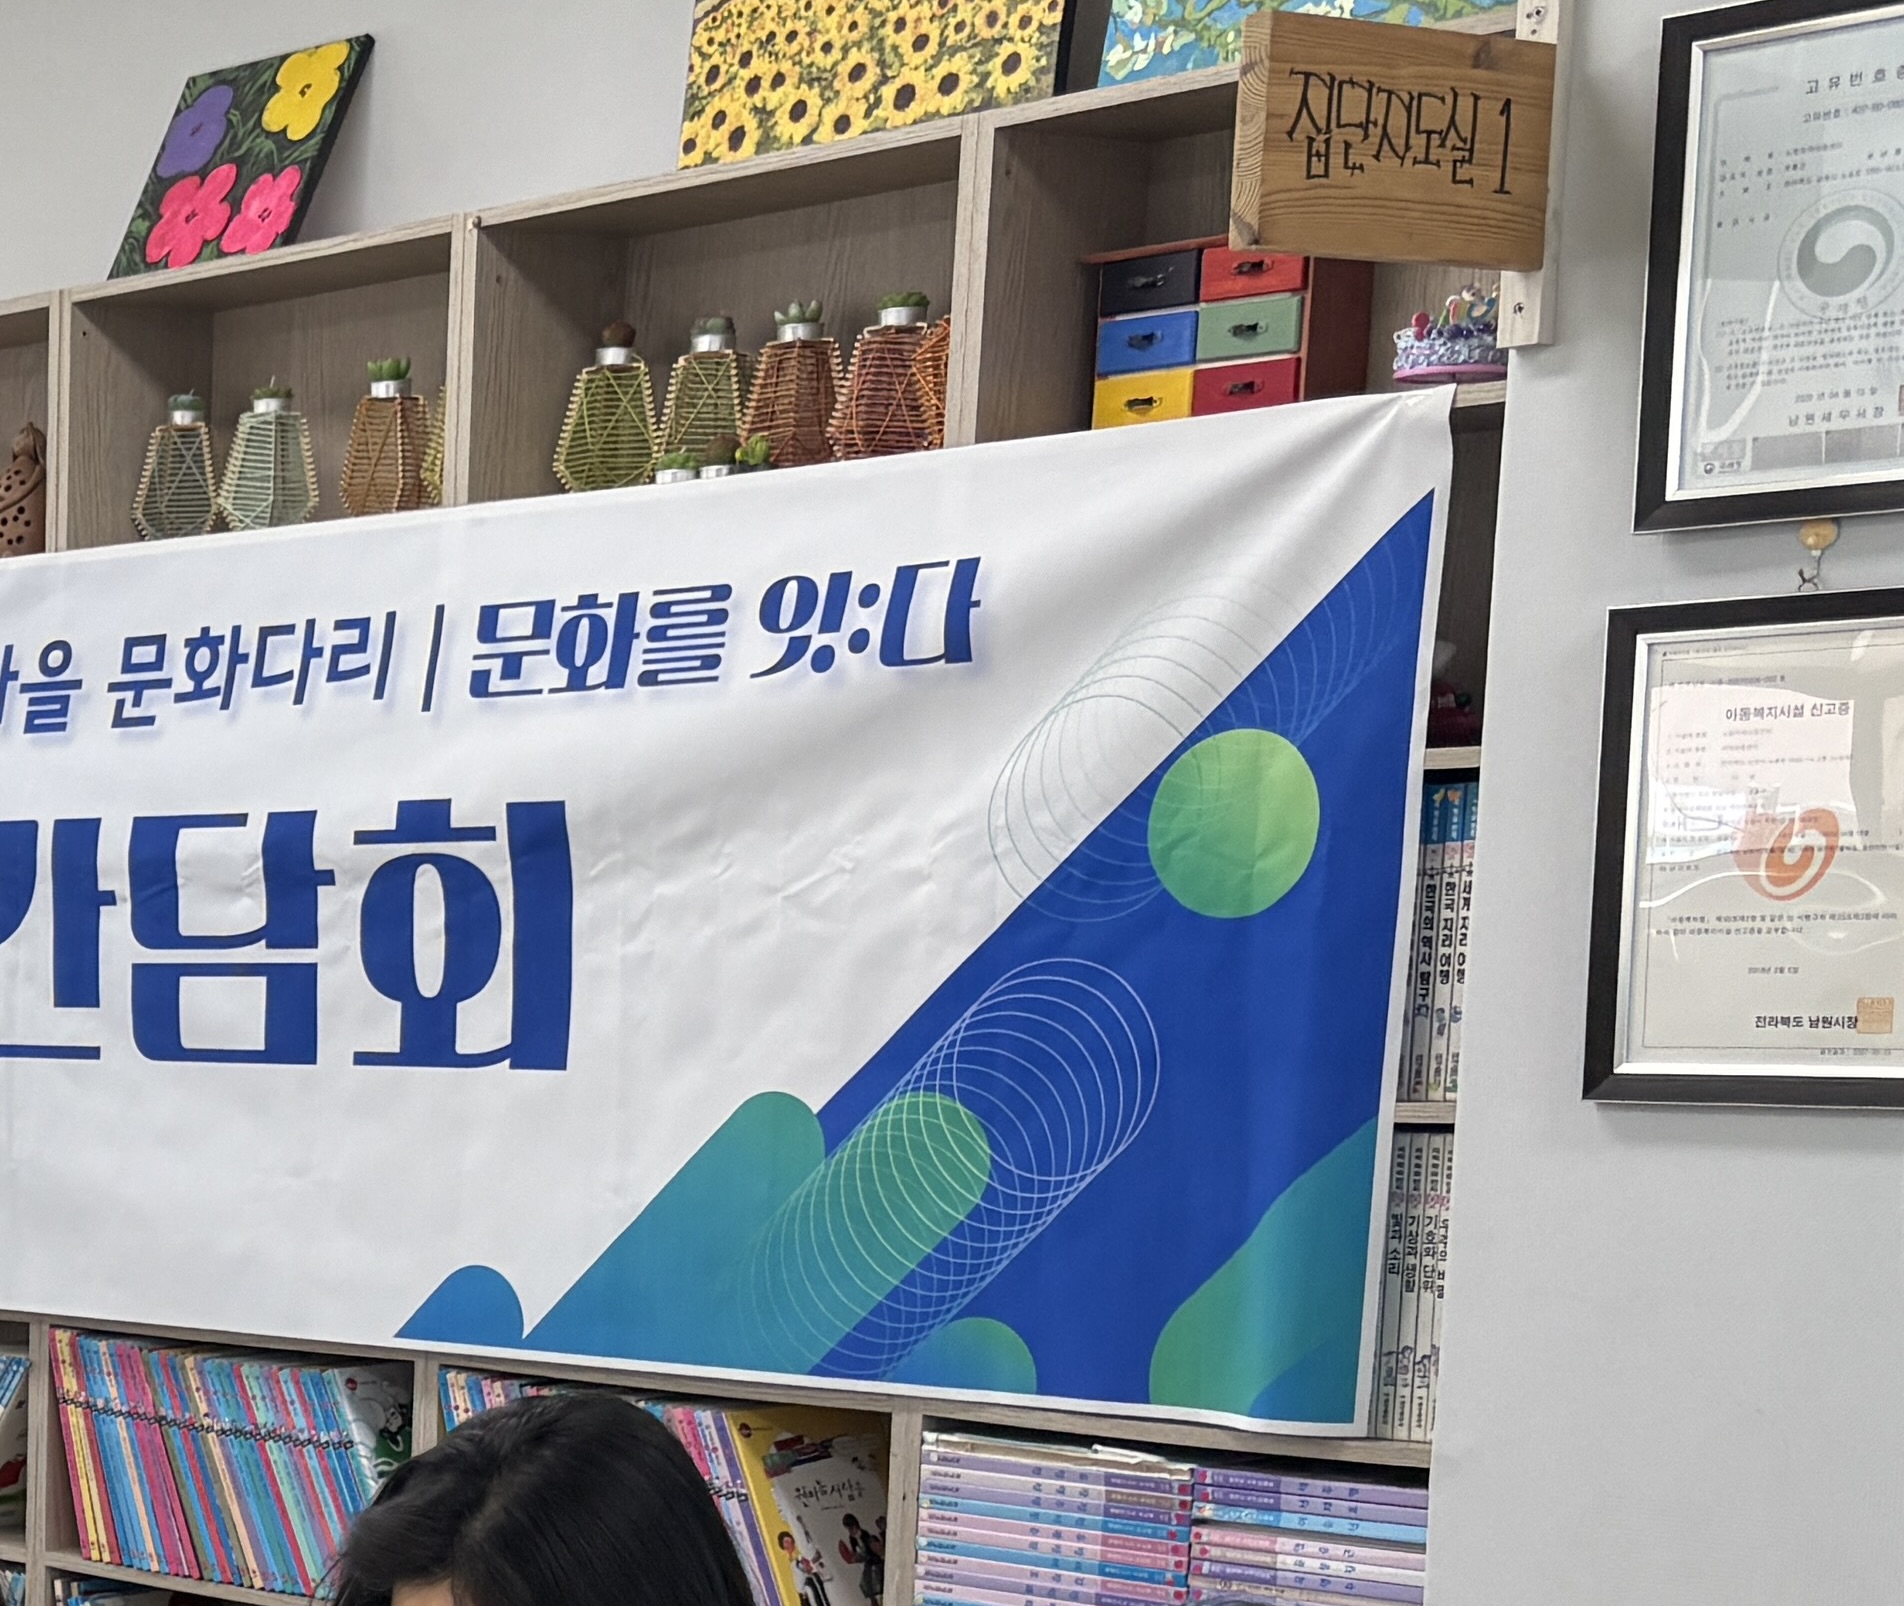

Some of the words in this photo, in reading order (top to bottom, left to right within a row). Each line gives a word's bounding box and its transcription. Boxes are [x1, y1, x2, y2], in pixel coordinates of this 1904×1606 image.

[1285, 67, 1479, 187] 집단지도실
[1493, 98, 1513, 195] 1
[107, 610, 398, 729] 문화다리
[469, 582, 733, 701] 문화를
[1810, 701, 1850, 717] 신고증
[1755, 1016, 1804, 1029] 전라북도
[1808, 1015, 1859, 1030] 남원시장
